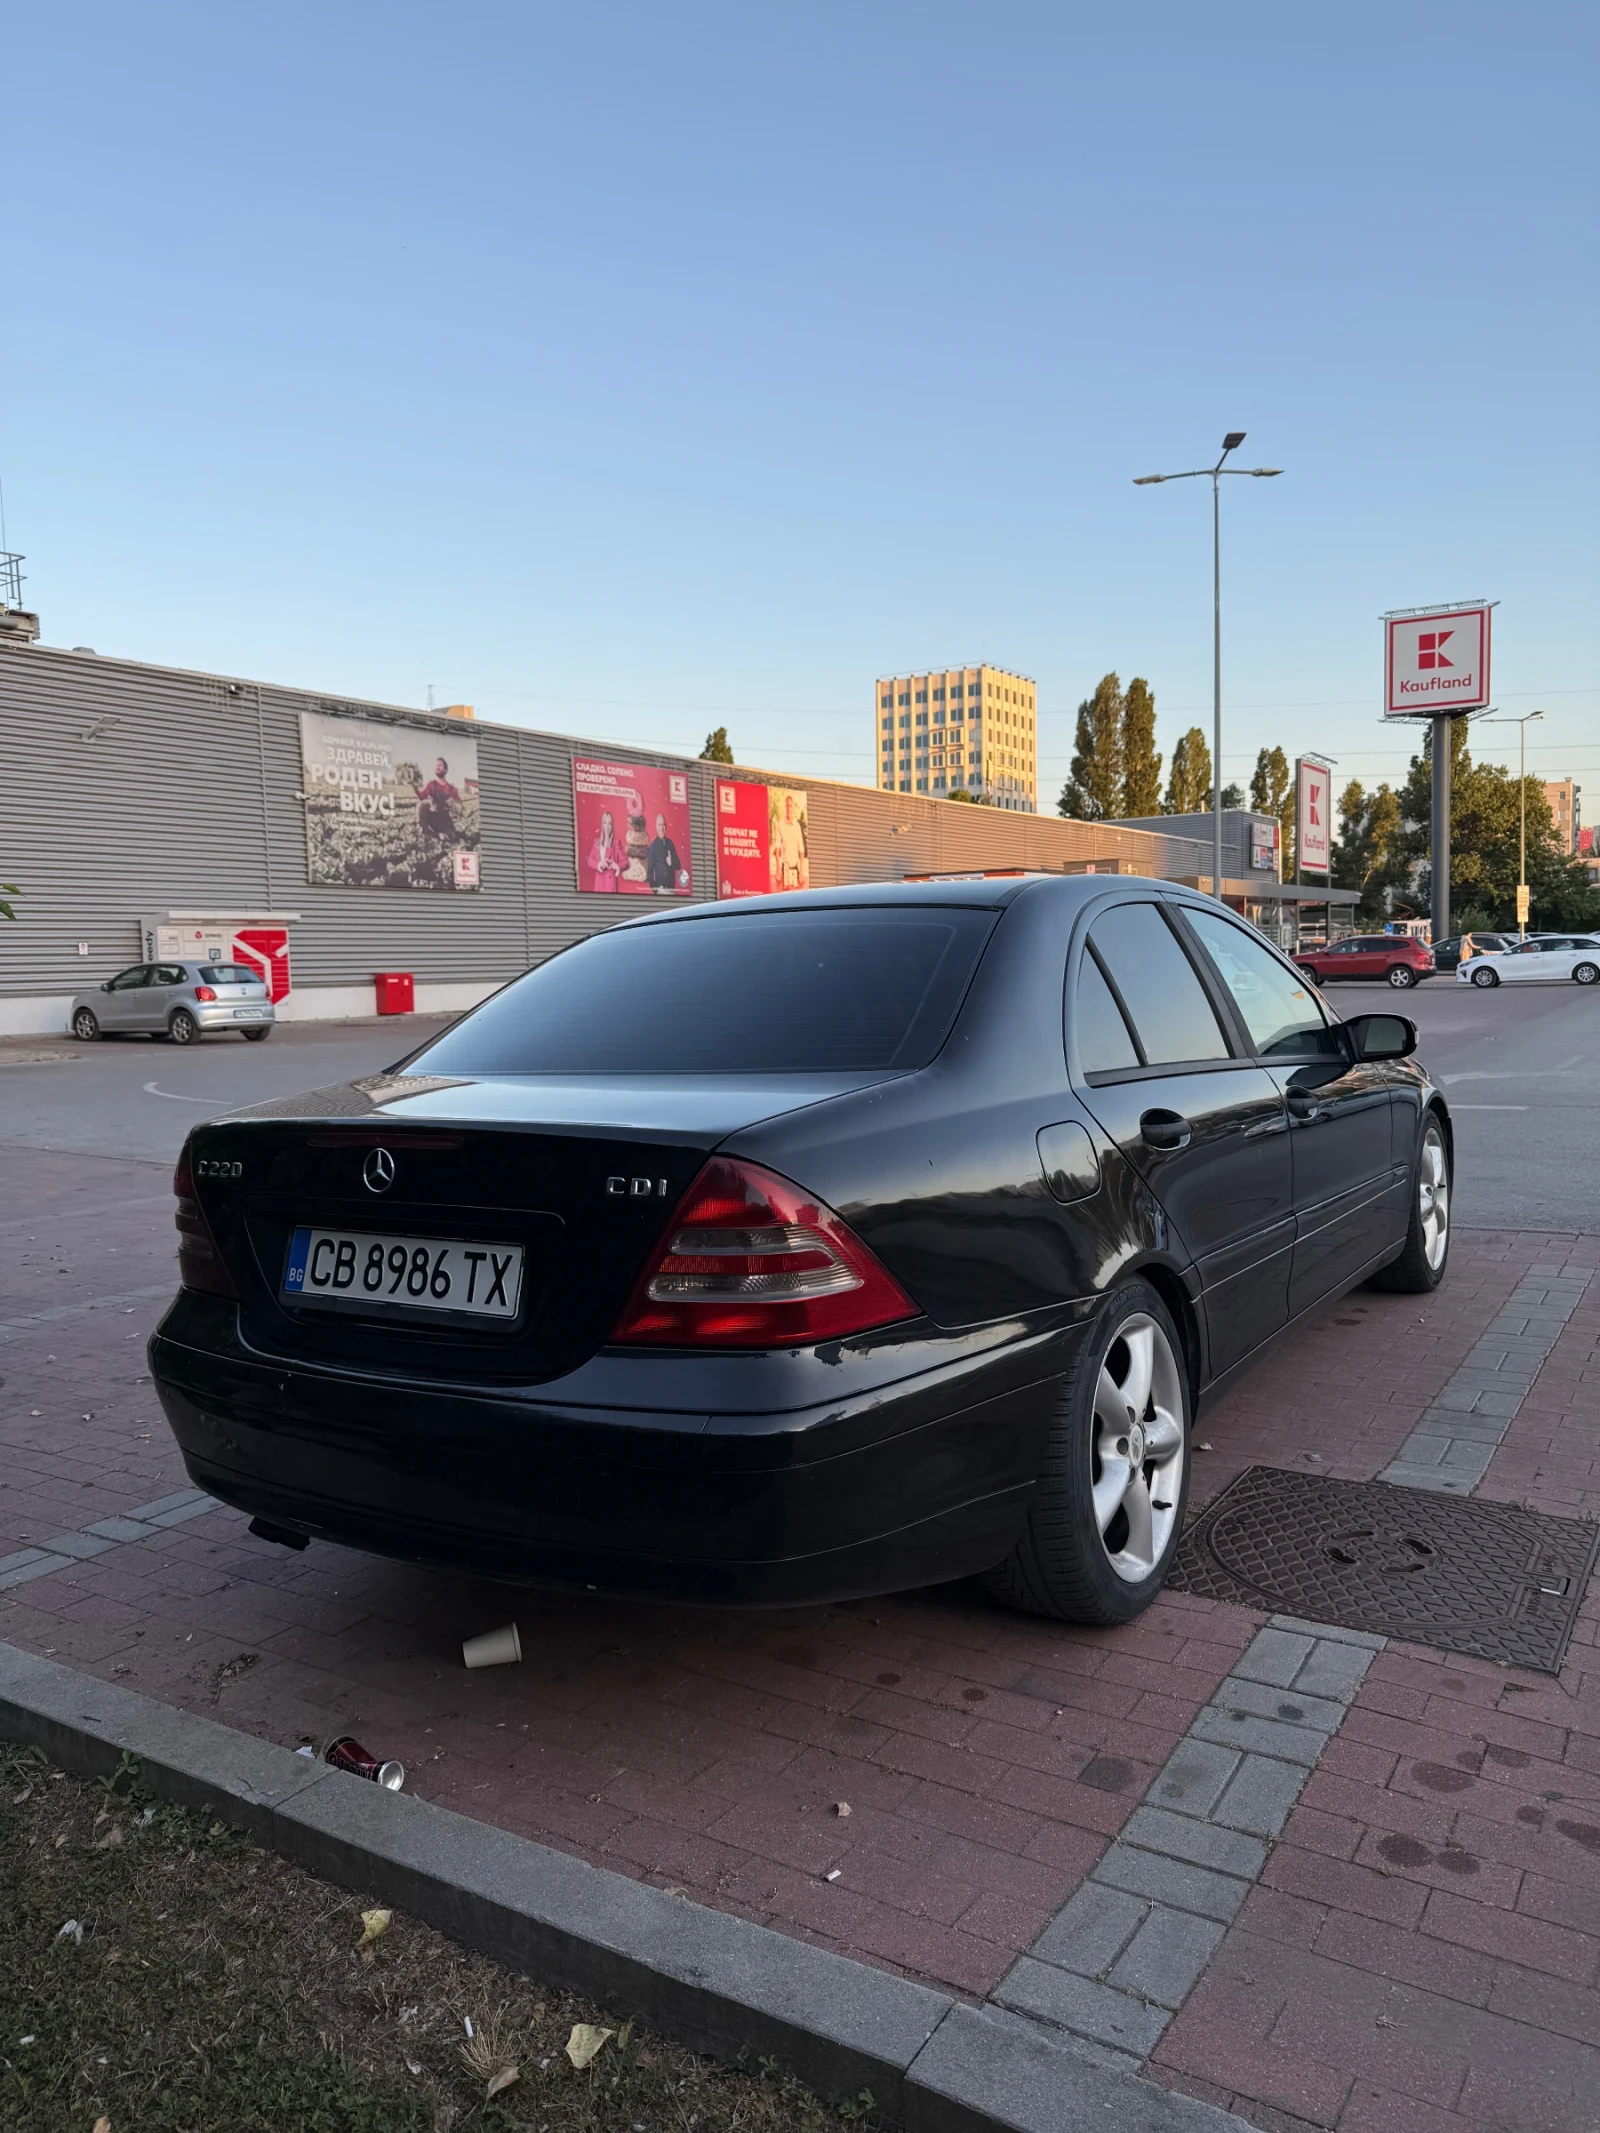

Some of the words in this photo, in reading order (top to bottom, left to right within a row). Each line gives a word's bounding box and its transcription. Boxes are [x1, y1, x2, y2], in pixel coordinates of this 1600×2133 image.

[1400, 673, 1472, 693] Kaufland
[326, 747, 392, 770] ЗДРАВЕЙ,
[310, 763, 383, 791] РОДЕН
[339, 790, 395, 816] ВКУС!
[198, 1160, 243, 1178] C220
[605, 1176, 668, 1197] CDI
[288, 1268, 304, 1282] BG
[310, 1238, 358, 1289] CB
[363, 1243, 452, 1300] 8986
[463, 1250, 514, 1307] TX
